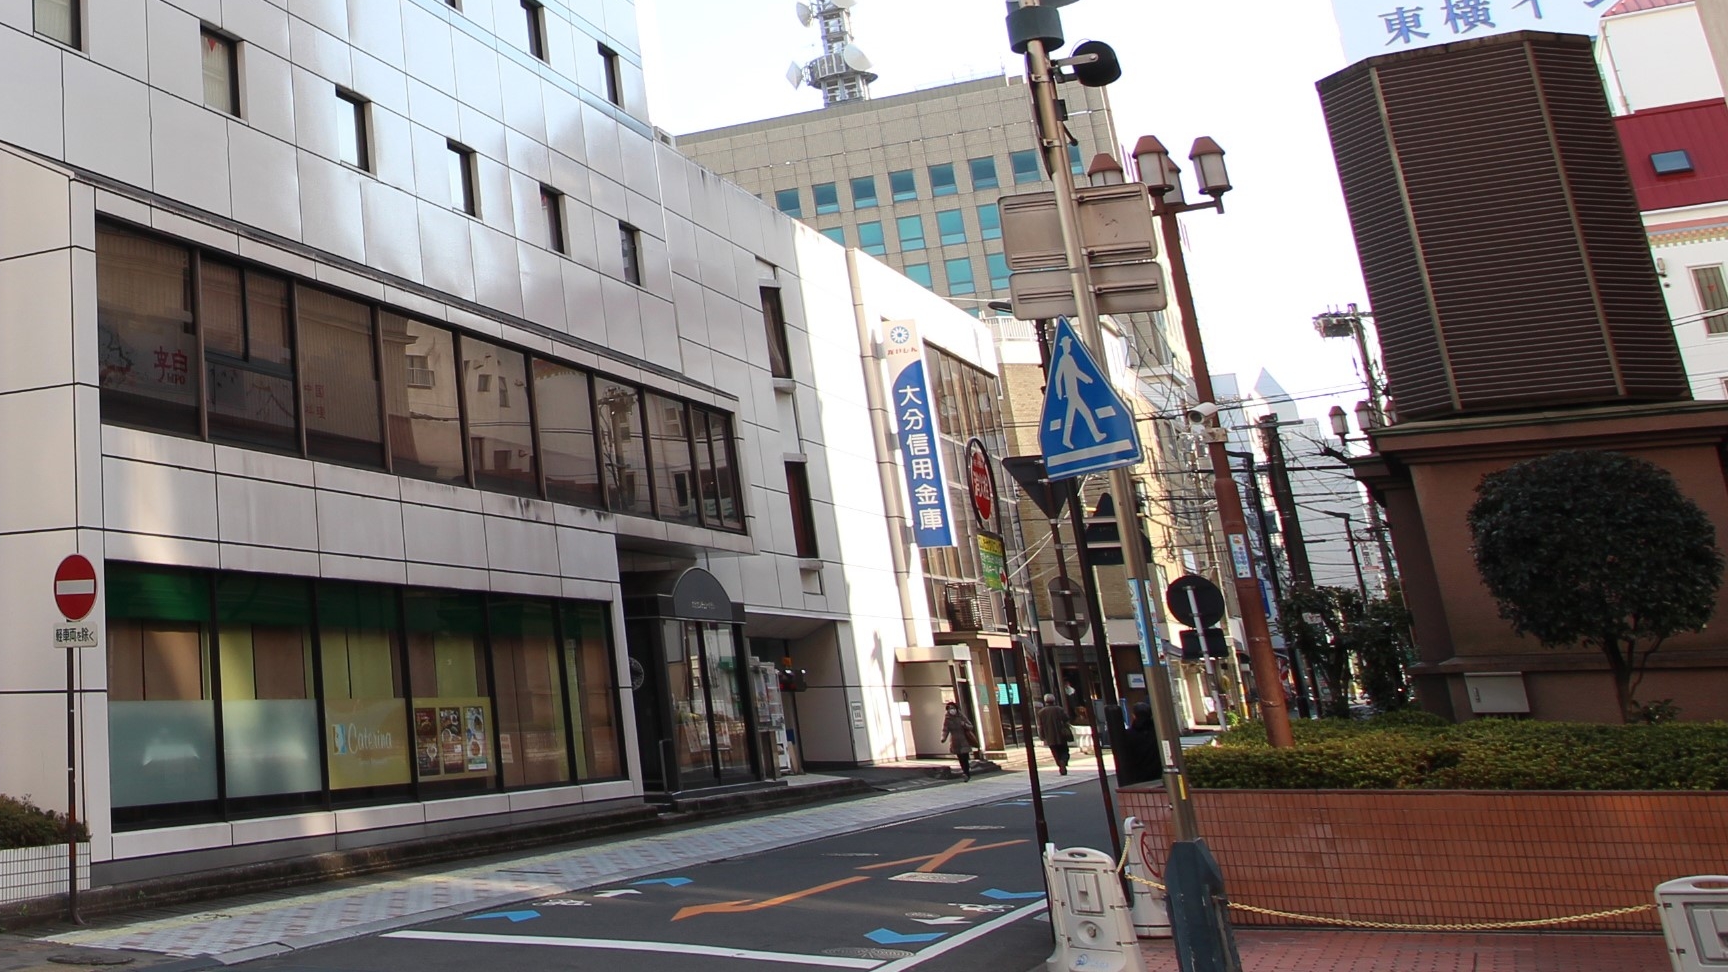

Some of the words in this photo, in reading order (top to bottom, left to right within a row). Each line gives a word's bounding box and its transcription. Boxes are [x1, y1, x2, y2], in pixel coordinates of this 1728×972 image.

[898, 385, 943, 531] 大分信用金庫
[55, 627, 94, 642] 軽車両を除く
